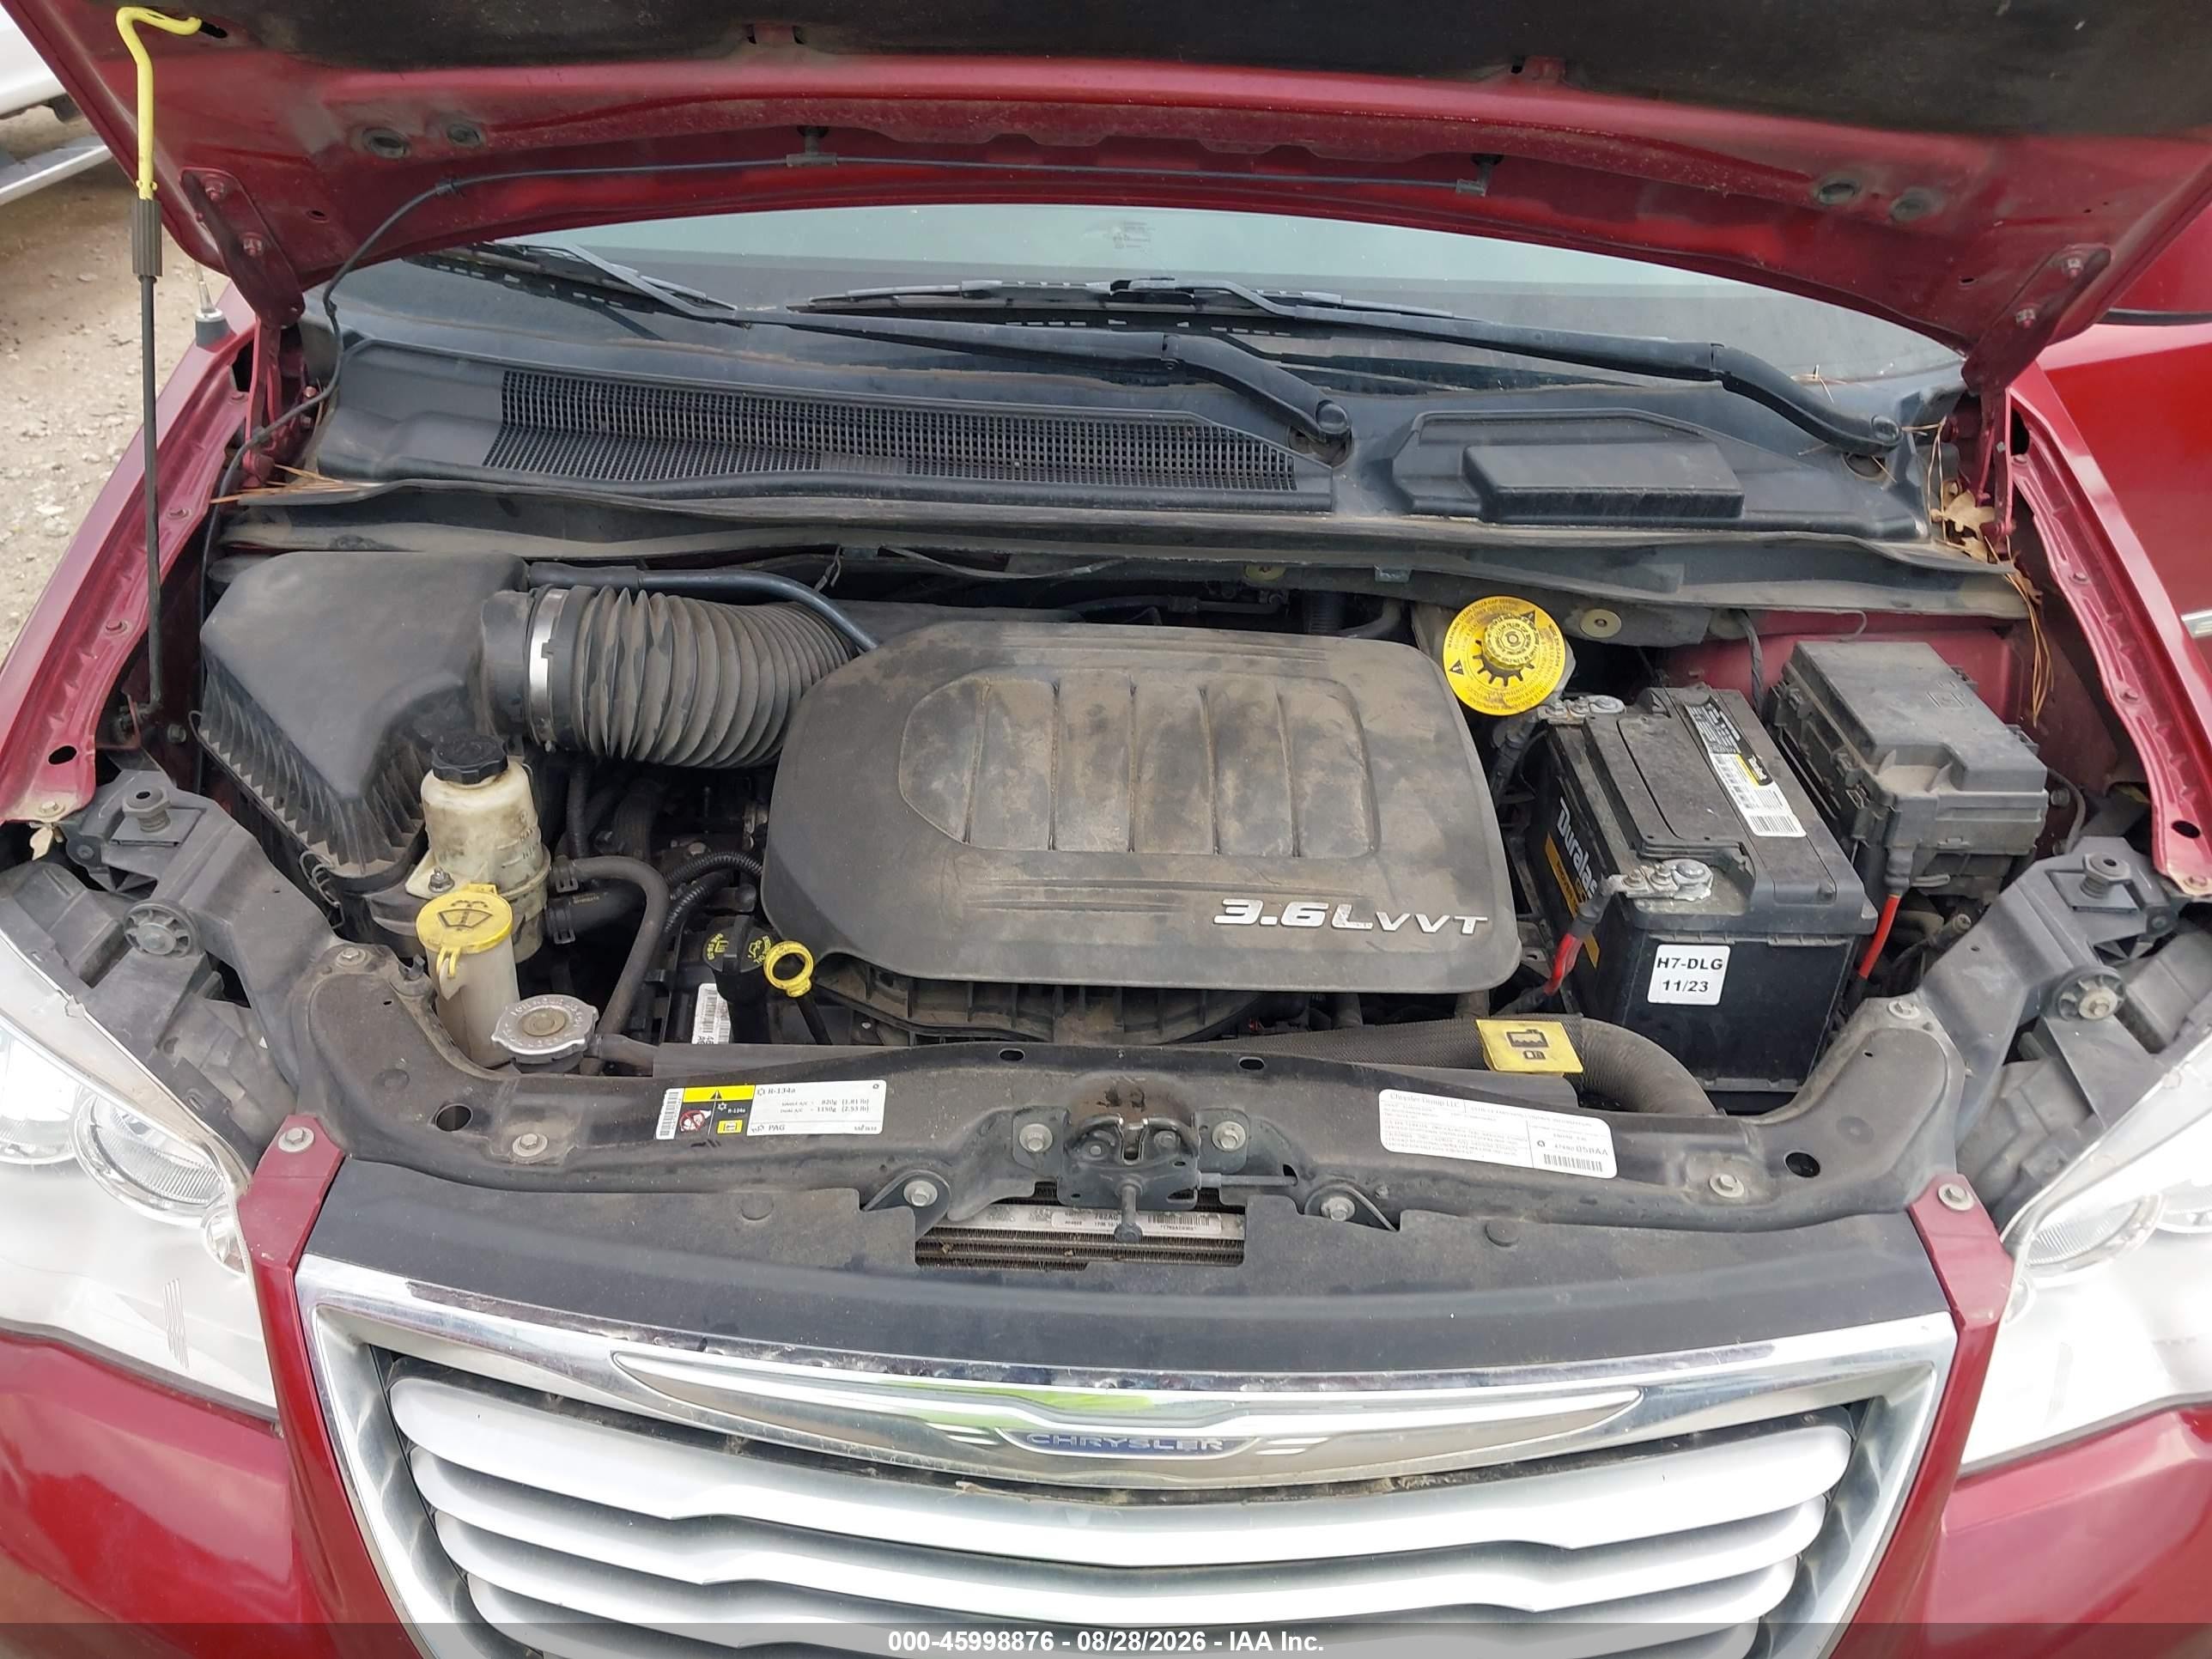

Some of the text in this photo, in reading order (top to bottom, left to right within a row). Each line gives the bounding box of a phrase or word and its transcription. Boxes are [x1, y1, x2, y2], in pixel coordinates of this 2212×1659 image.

[1557, 797, 1598, 900] Duralas
[1656, 956, 1723, 971] H7-DLG
[1662, 979, 1709, 994] 11/23
[1025, 1432, 1224, 1453] CHRYSLER
